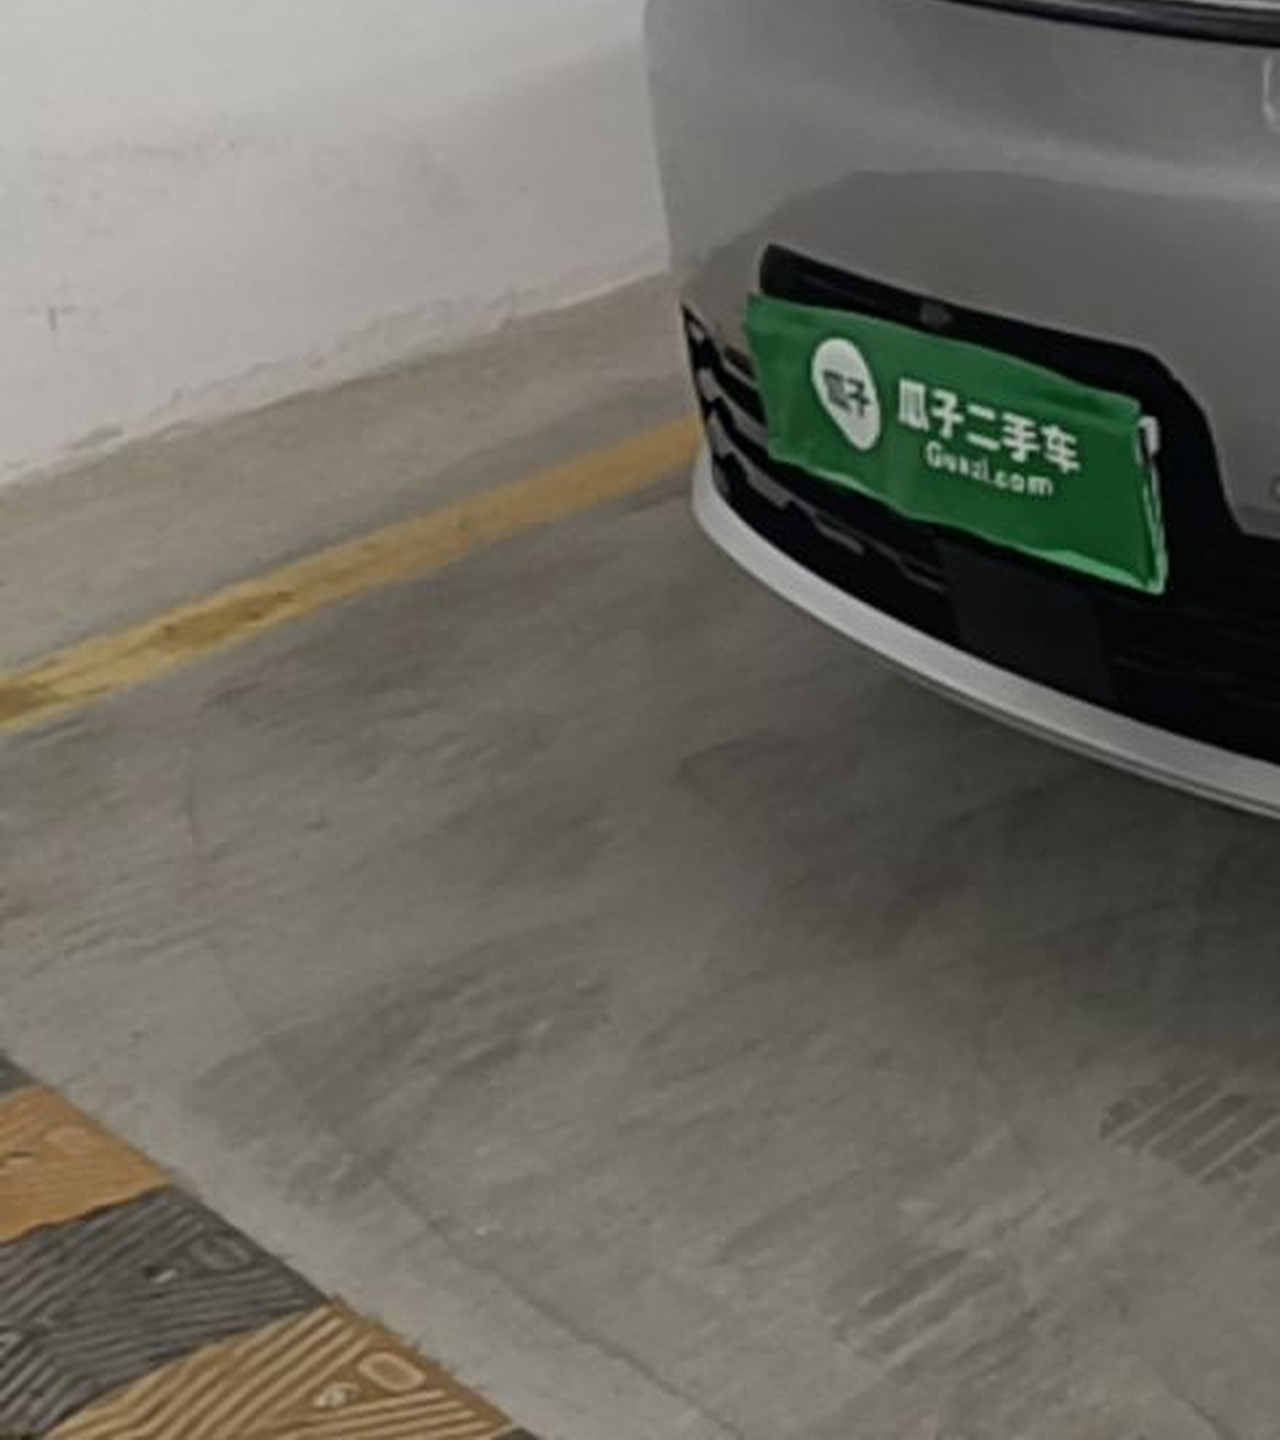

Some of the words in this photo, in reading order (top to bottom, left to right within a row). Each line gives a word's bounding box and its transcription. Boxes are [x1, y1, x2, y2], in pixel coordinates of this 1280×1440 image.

[897, 376, 1081, 475] 瓜子二手车
[924, 440, 1054, 497] Guazi.com
